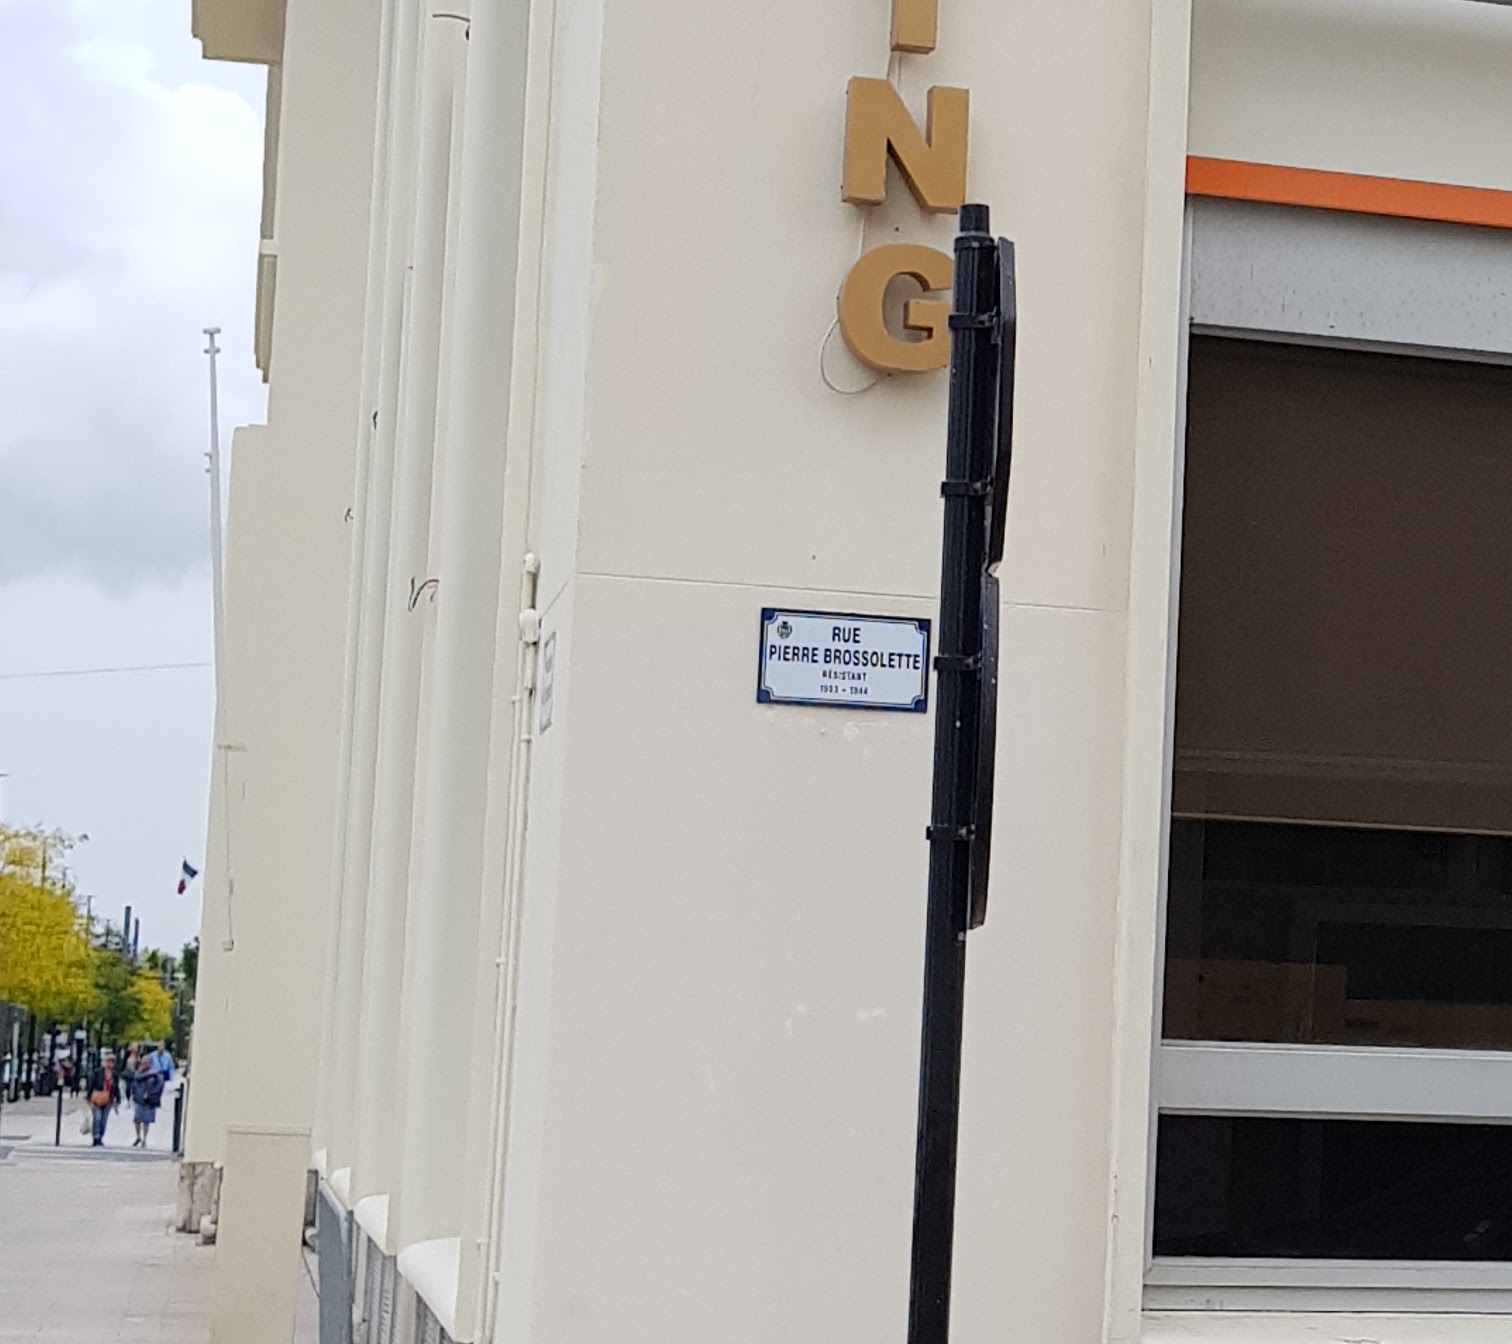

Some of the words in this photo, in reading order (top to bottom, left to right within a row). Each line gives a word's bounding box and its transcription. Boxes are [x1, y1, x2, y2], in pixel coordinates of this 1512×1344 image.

[832, 626, 861, 644] RUE
[769, 644, 819, 663] PIERRE
[824, 648, 921, 670] BROSSOLETTE
